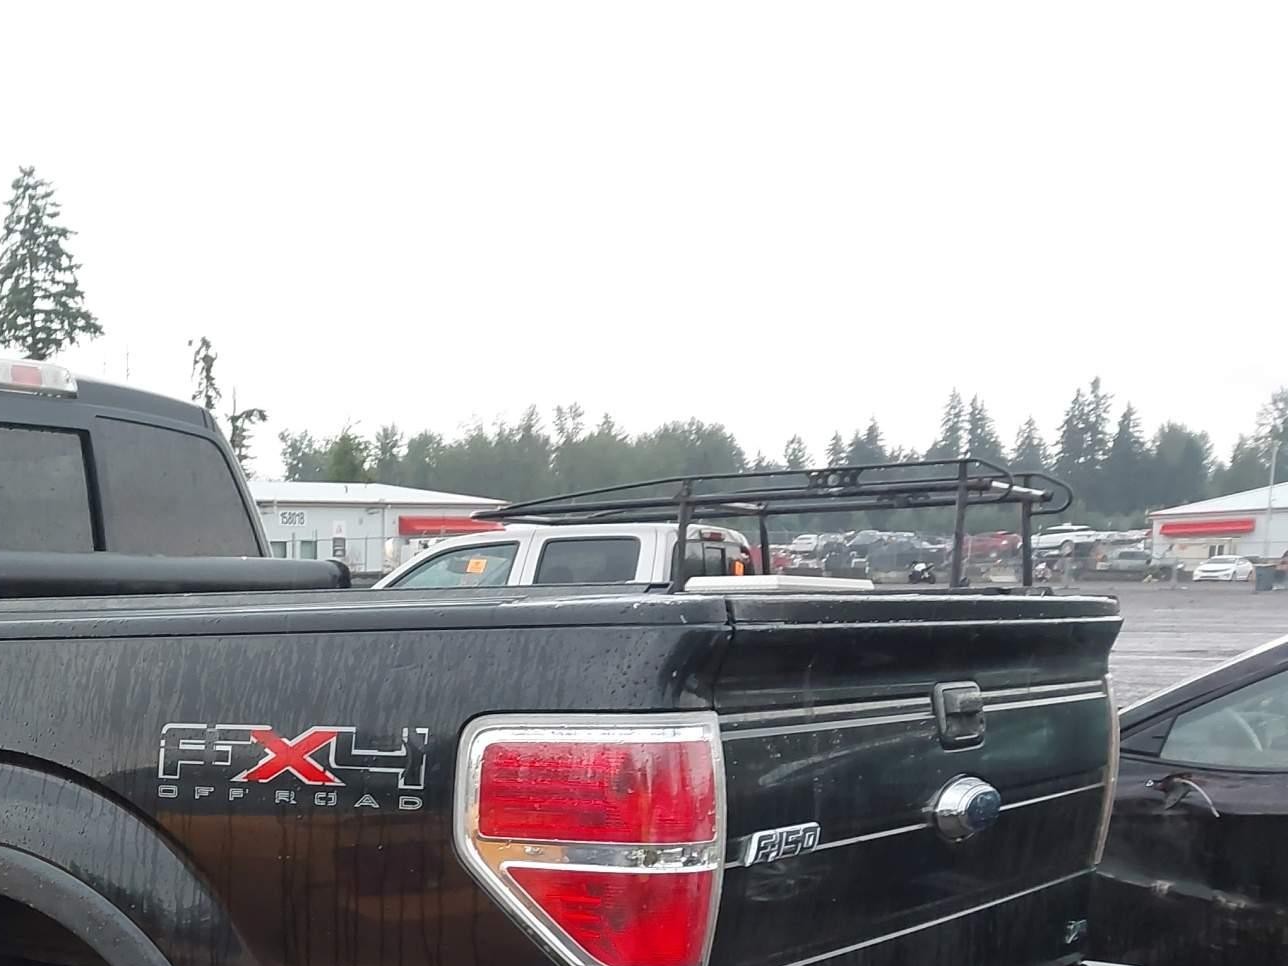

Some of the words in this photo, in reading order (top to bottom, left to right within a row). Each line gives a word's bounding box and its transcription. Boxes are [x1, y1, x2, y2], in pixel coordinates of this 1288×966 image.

[158, 723, 429, 789] FX4
[158, 785, 249, 801] OFF
[274, 790, 423, 810] ROAD
